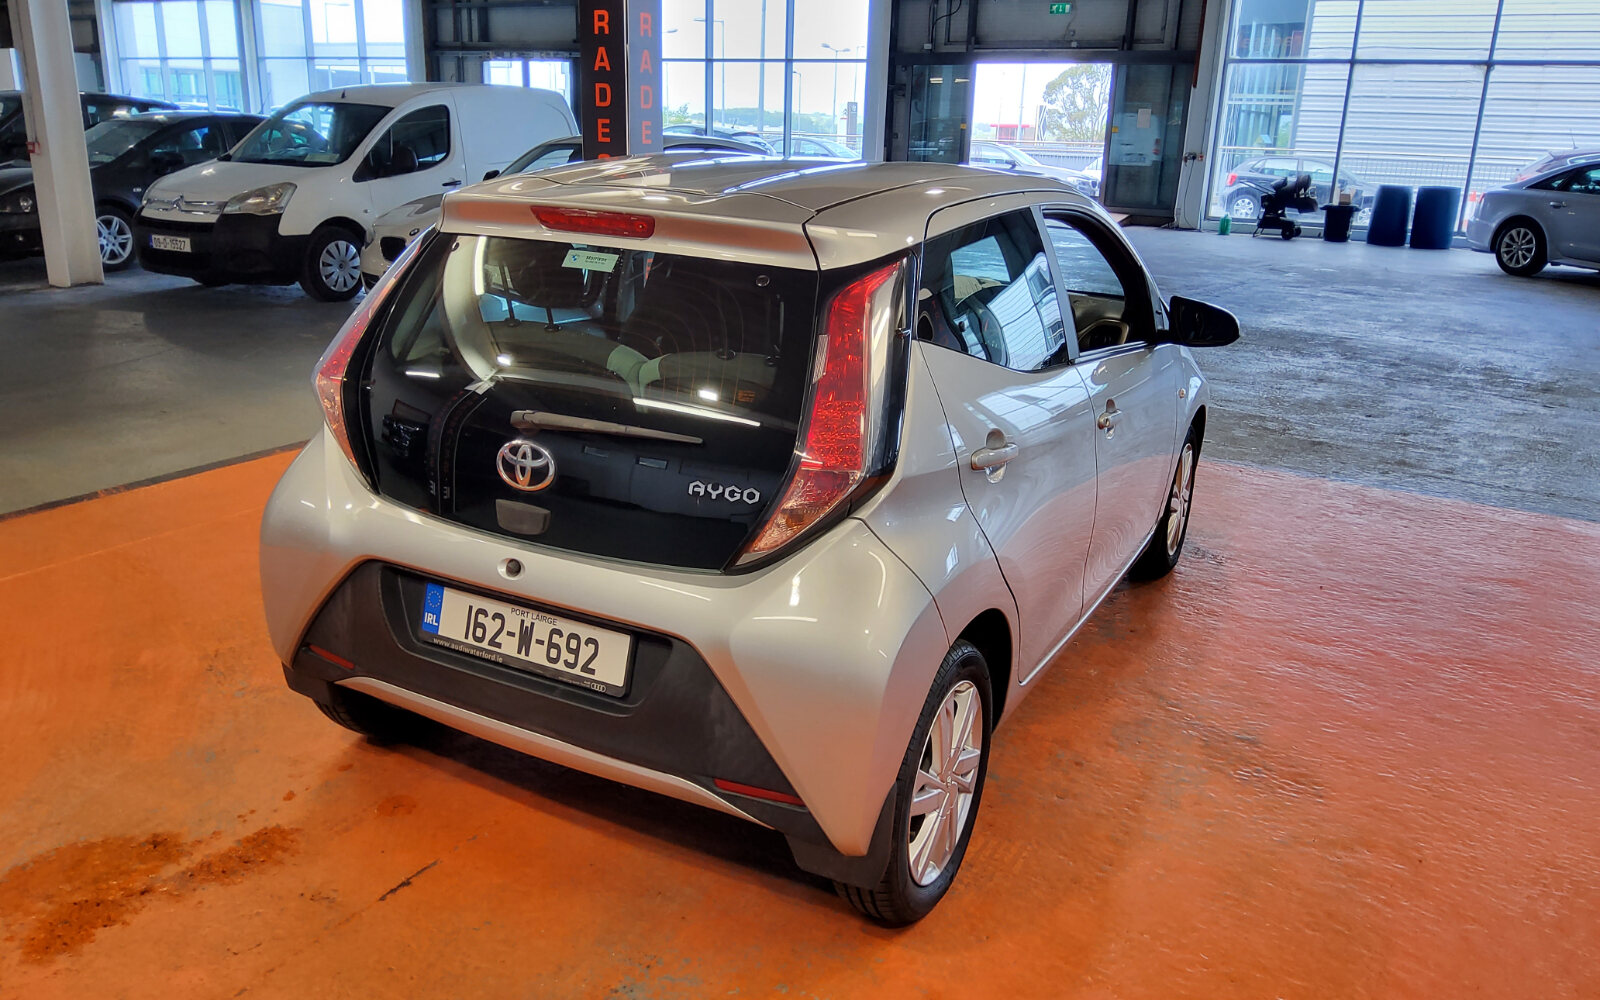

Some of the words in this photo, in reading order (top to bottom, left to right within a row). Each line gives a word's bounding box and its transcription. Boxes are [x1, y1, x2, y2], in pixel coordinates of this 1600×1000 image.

[593, 9, 611, 160] RADE
[639, 12, 653, 157] RADE
[688, 480, 760, 504] AYGO
[424, 611, 439, 626] IRL
[511, 608, 530, 618] PORT
[433, 637, 503, 663] www.audiwaterford.ie
[464, 604, 600, 675] 162-W-692
